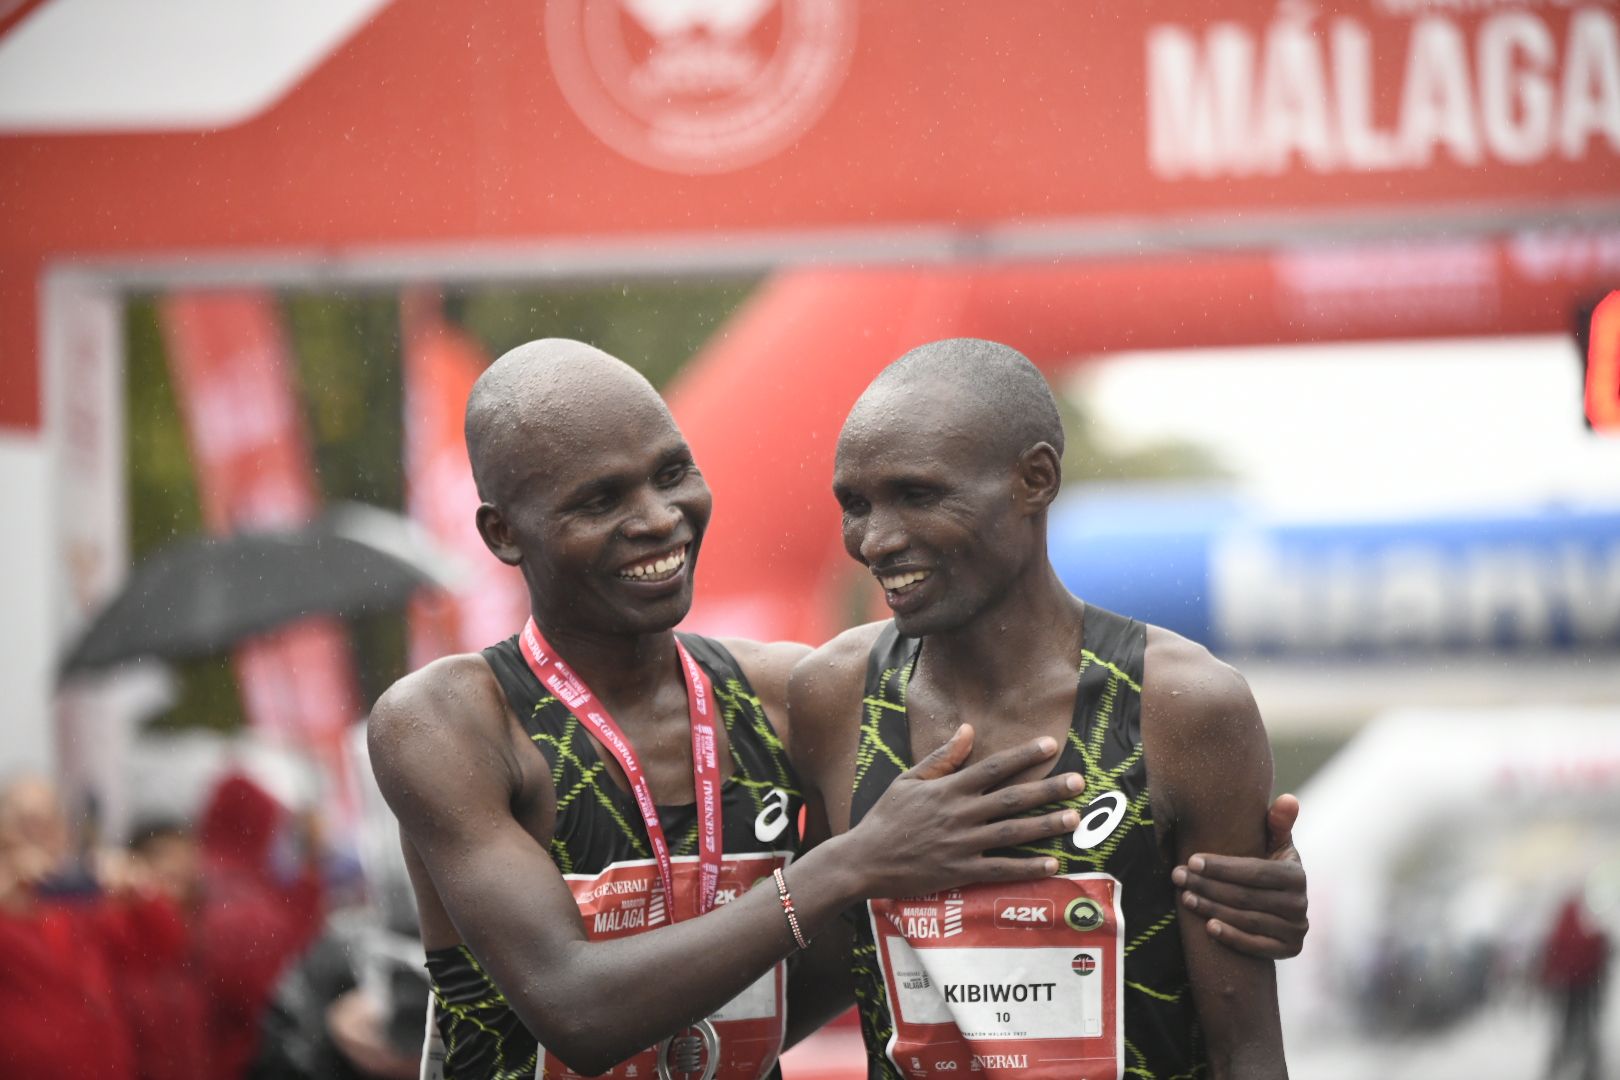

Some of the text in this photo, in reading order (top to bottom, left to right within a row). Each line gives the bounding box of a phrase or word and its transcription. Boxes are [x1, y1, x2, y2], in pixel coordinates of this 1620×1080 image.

[1146, 0, 1620, 180] MÁLAGA
[599, 723, 637, 772] GENERALI
[703, 781, 715, 835] GENERALI
[594, 879, 648, 898] GENERALI
[714, 889, 736, 904] 2K
[594, 908, 645, 933] MÁLAGA
[903, 907, 937, 917] MARATÓN
[1001, 907, 1048, 922] 42K
[943, 983, 1056, 1003] KIBIWOTT
[996, 1012, 1011, 1023] 10
[977, 1055, 1028, 1069] NERALI
